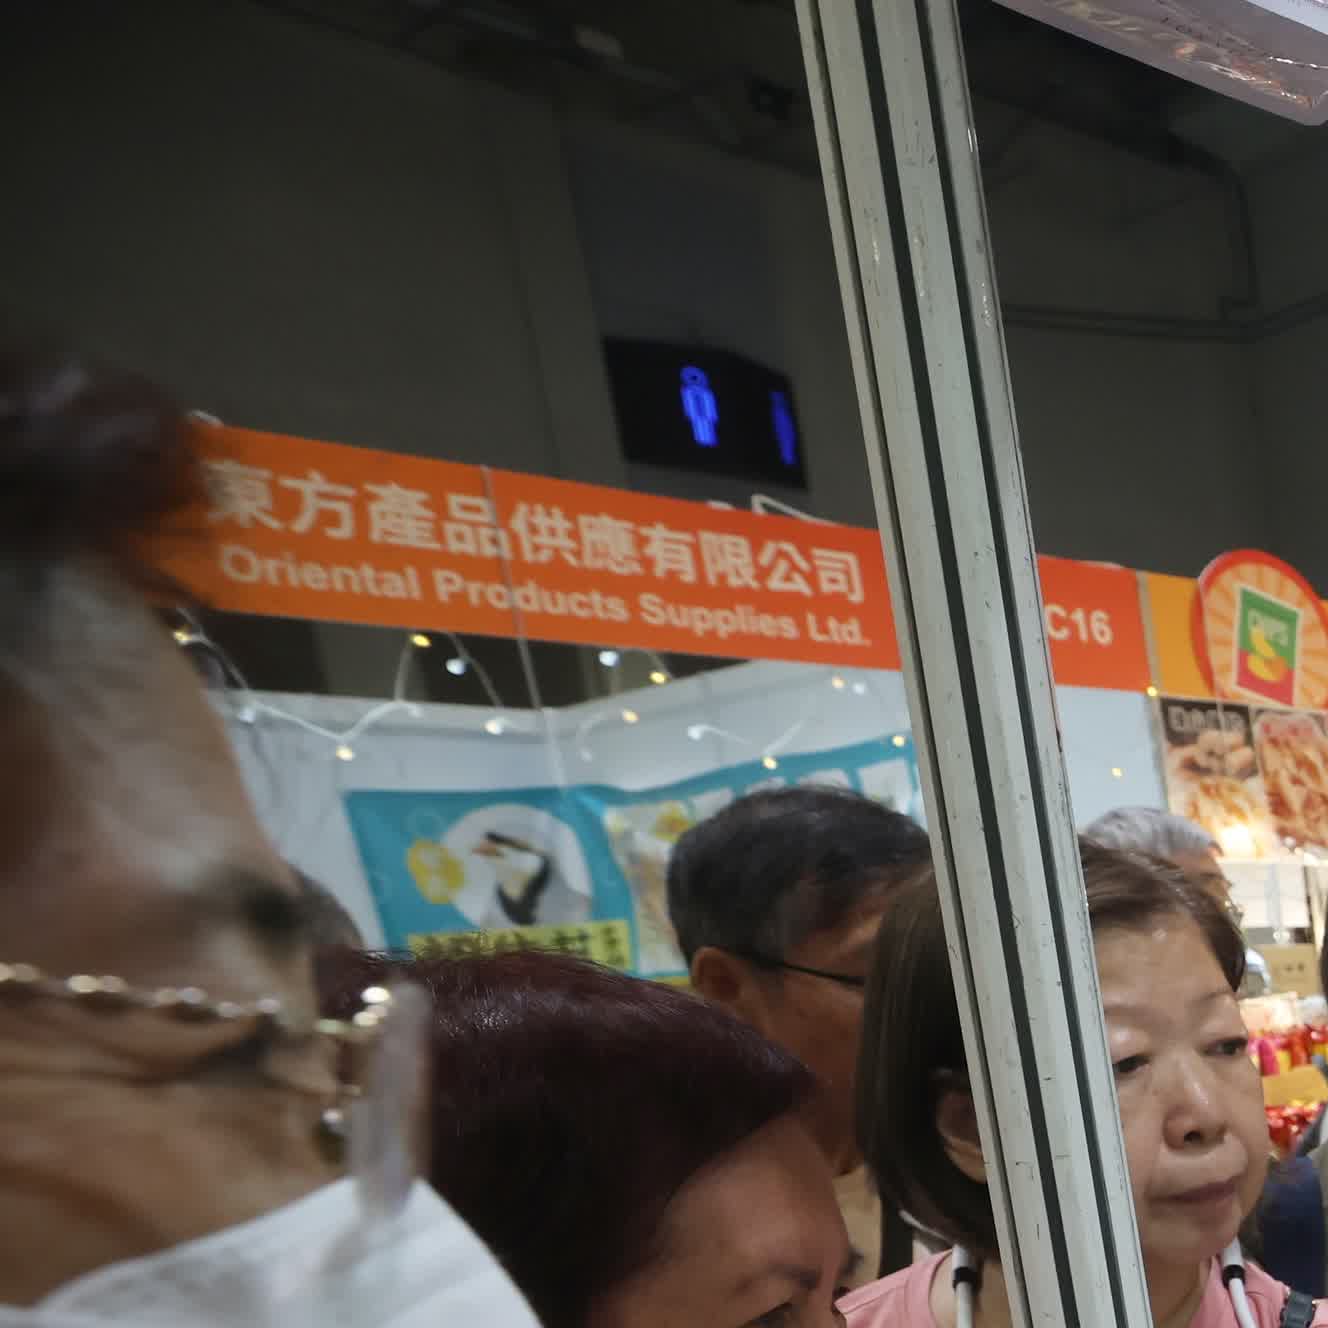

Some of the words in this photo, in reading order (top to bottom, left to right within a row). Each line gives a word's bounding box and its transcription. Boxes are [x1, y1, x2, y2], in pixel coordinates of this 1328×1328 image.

[204, 460, 865, 604] 東方產品供應有限公司
[219, 544, 419, 601] Oriental
[434, 569, 629, 623] Products
[640, 596, 797, 643] Supplies
[807, 616, 870, 647] Ltd.
[1044, 603, 1114, 647] C16
